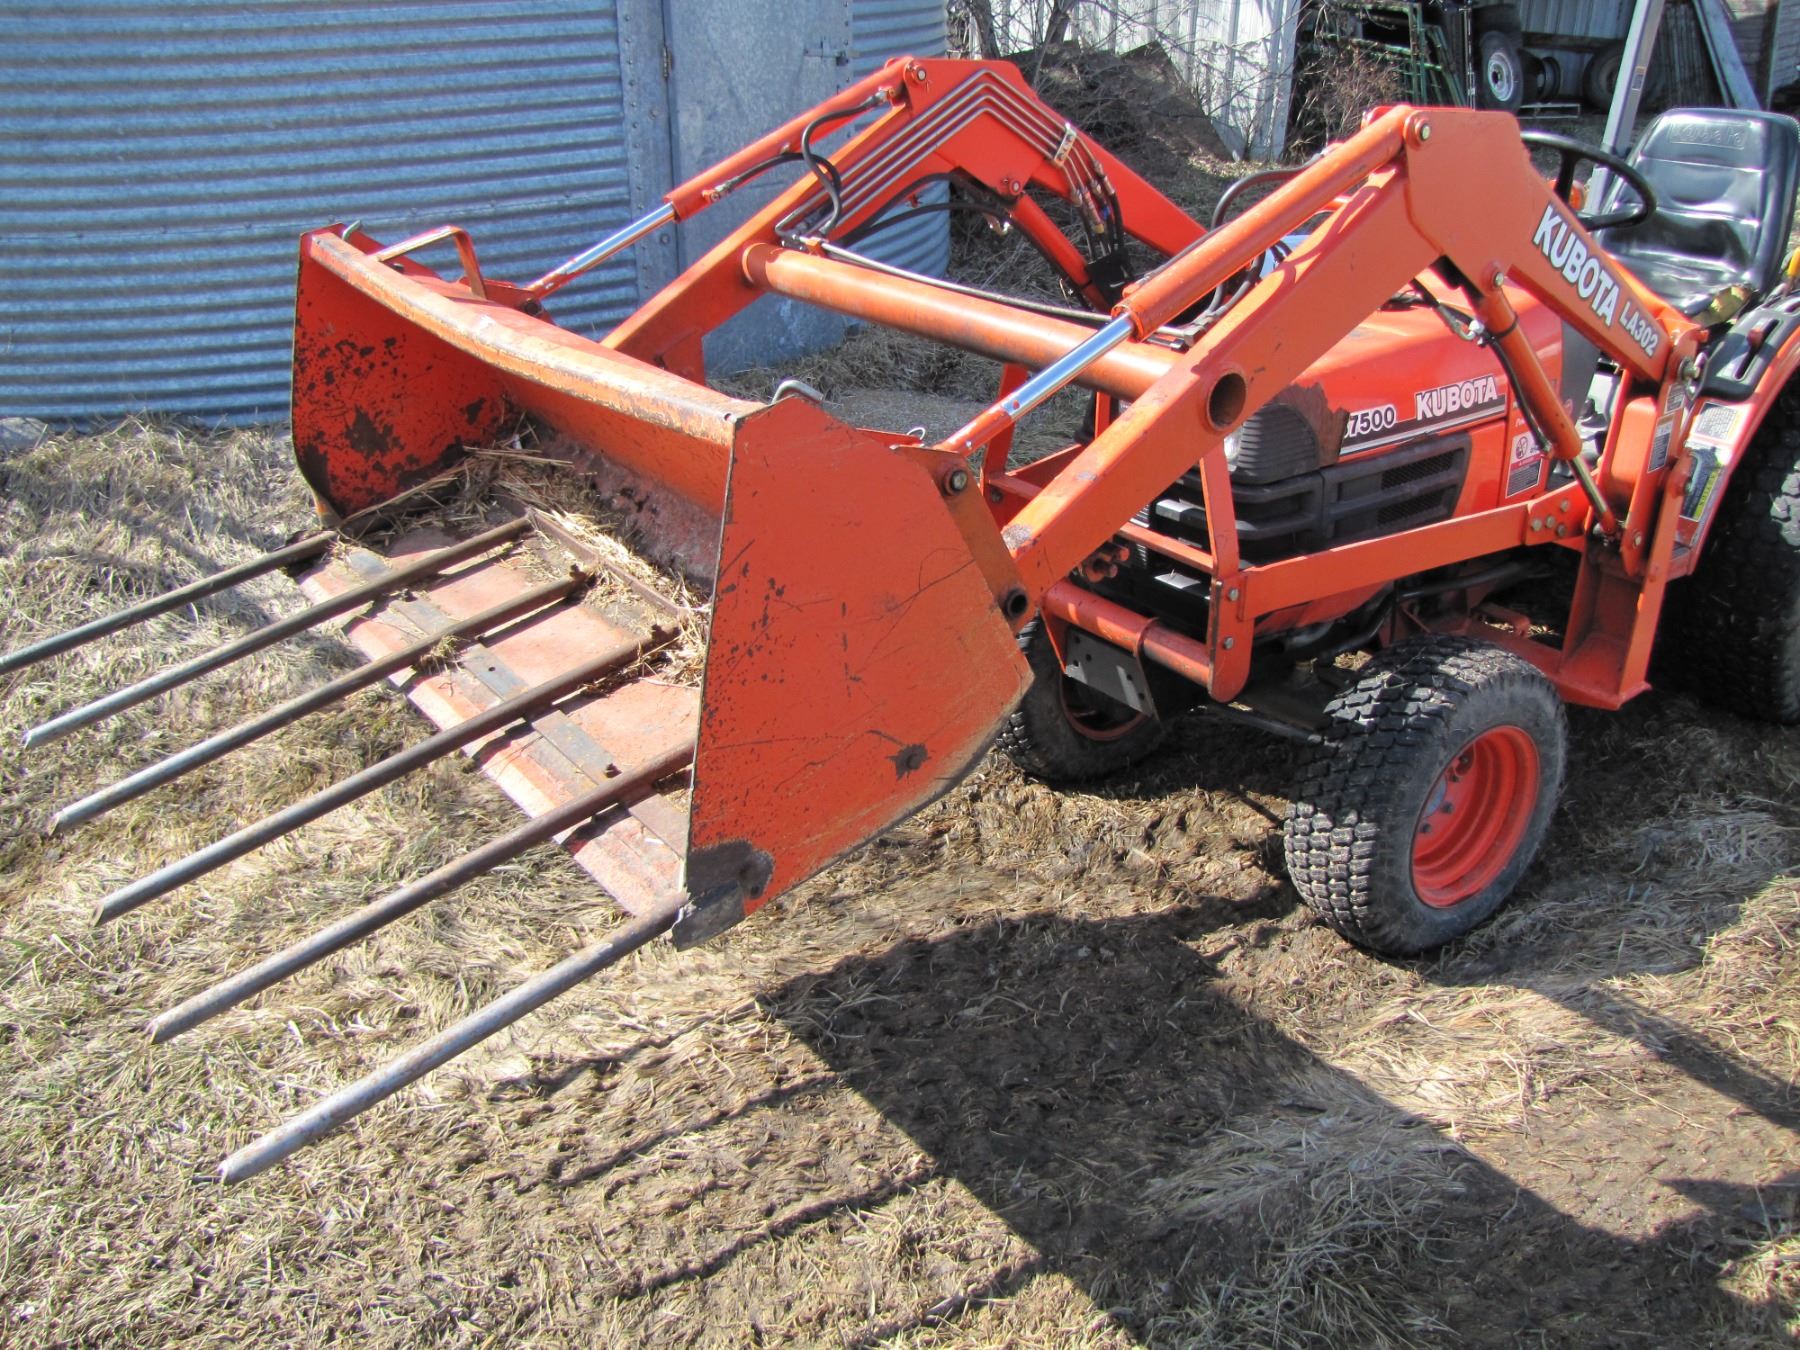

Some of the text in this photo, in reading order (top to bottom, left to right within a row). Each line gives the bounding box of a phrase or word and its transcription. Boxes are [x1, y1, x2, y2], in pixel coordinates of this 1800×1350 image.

[1533, 203, 1660, 357] KUBOTA LA302
[1343, 375, 1498, 438] 7500 KUBOTA
